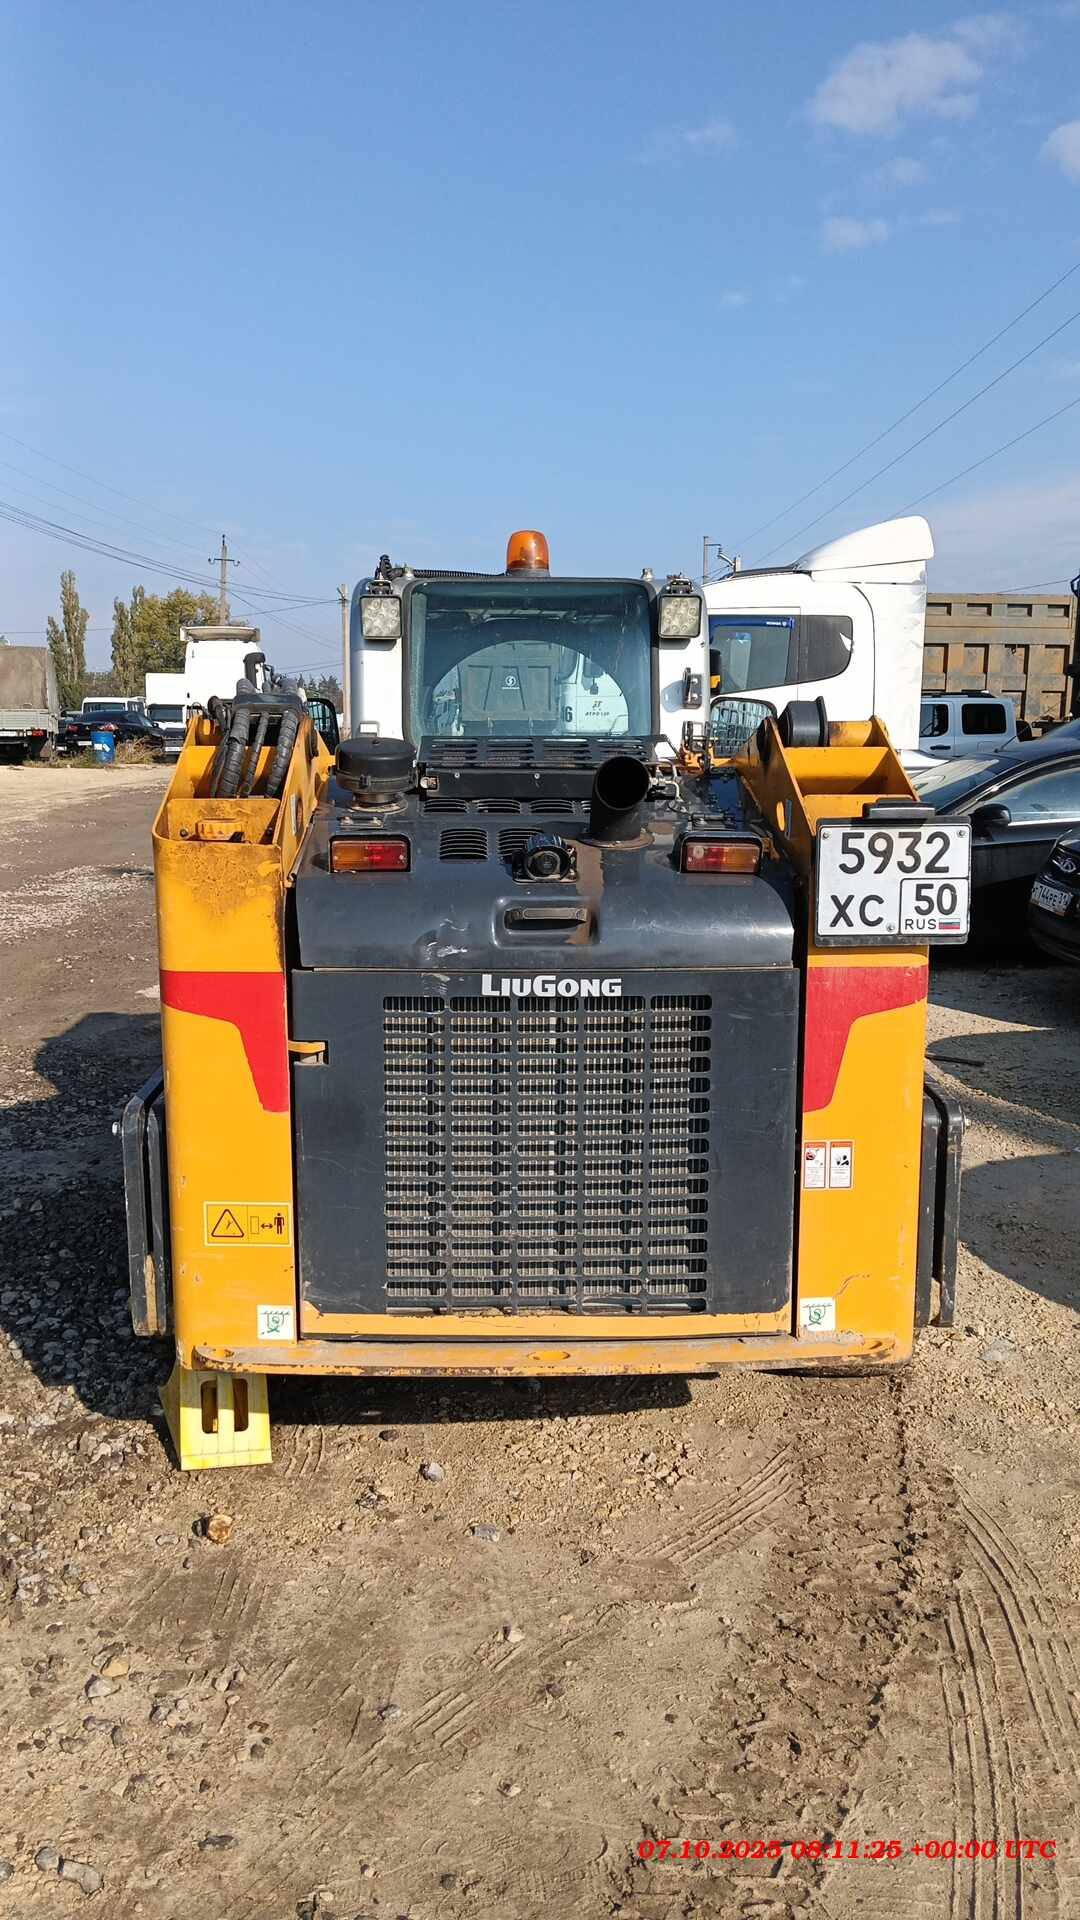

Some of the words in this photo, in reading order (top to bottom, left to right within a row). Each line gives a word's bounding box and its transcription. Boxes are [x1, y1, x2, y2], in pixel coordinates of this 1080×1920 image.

[838, 831, 951, 875] 5932
[914, 883, 958, 916] 50
[905, 918, 937, 930] RUS
